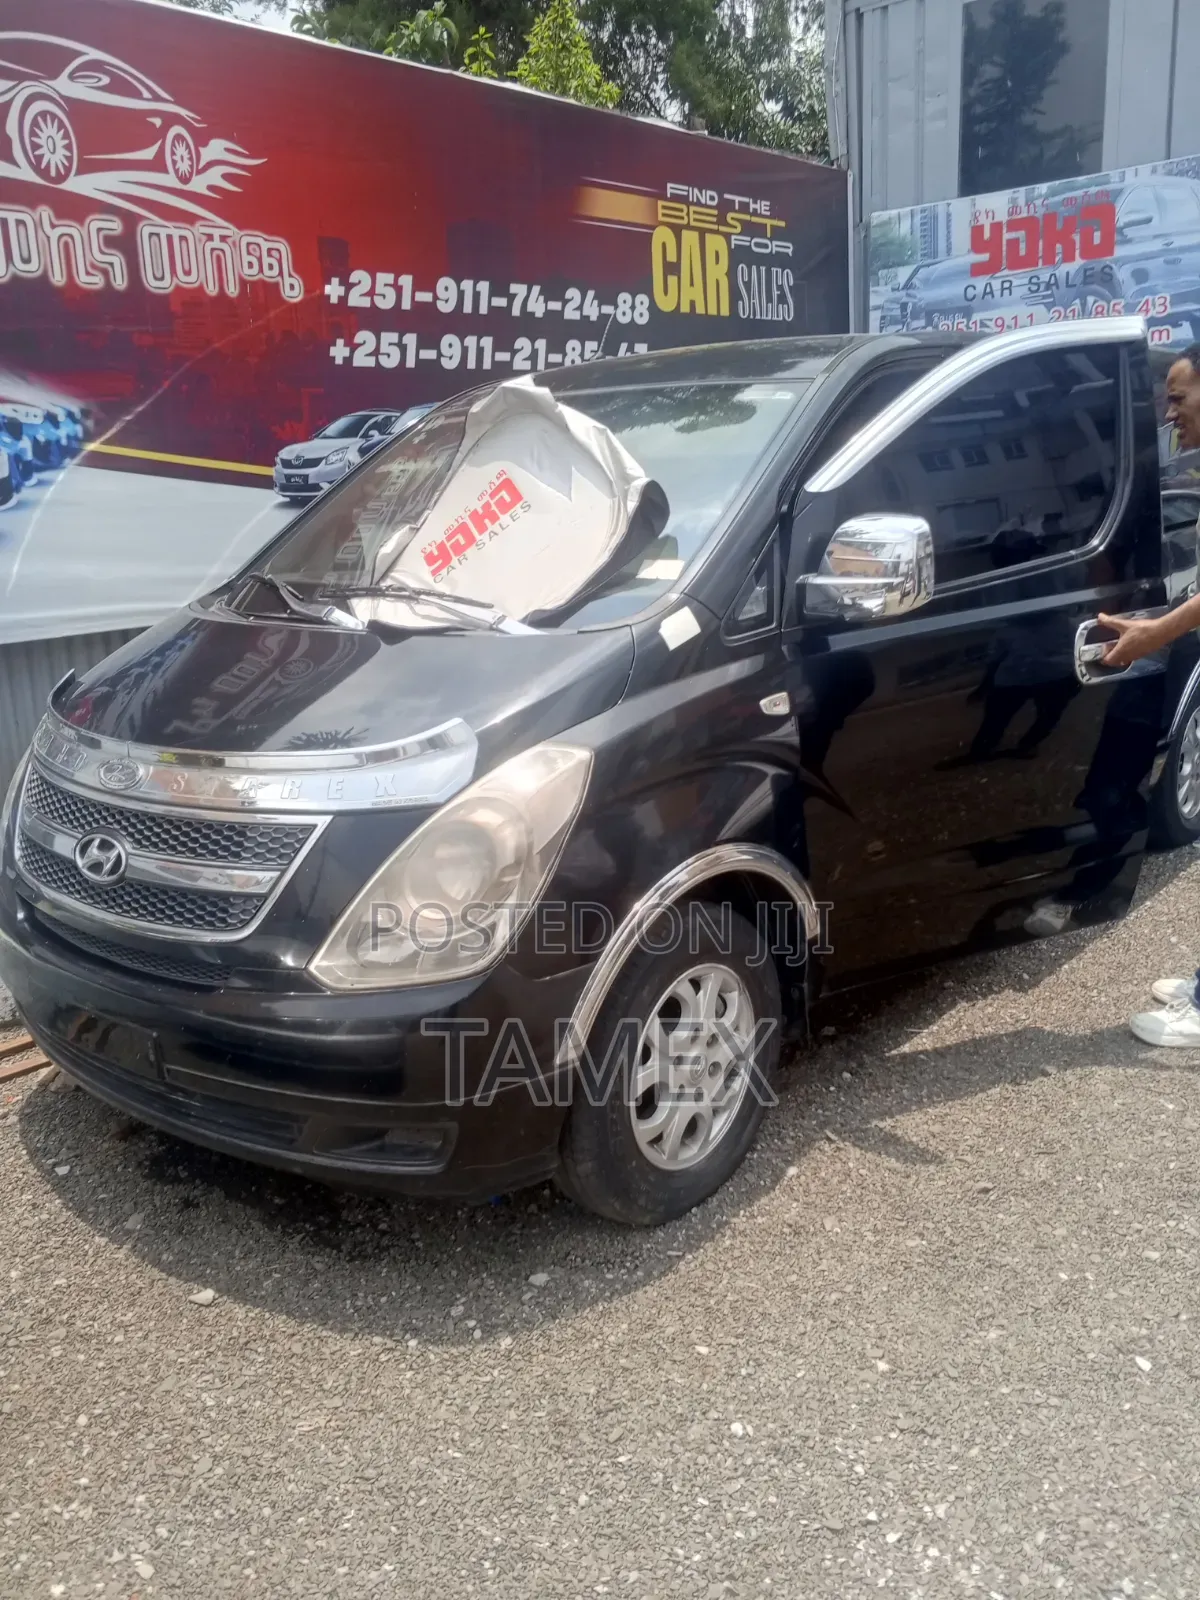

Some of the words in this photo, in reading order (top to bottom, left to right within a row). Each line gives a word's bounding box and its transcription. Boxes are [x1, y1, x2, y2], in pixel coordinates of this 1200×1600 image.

[667, 182, 718, 206] FIND
[723, 193, 771, 216] THE
[658, 200, 786, 238] BEST
[731, 235, 793, 257] FOR
[651, 225, 730, 317] CAR
[963, 279, 1014, 302] CAR
[1027, 264, 1114, 294] SALES
[324, 269, 650, 325] +251-911-74-24-88
[737, 263, 794, 321] SALES
[994, 312, 1037, 333] 911
[1138, 296, 1168, 317] 43
[433, 553, 469, 584] CAR
[475, 500, 532, 551] SALES
